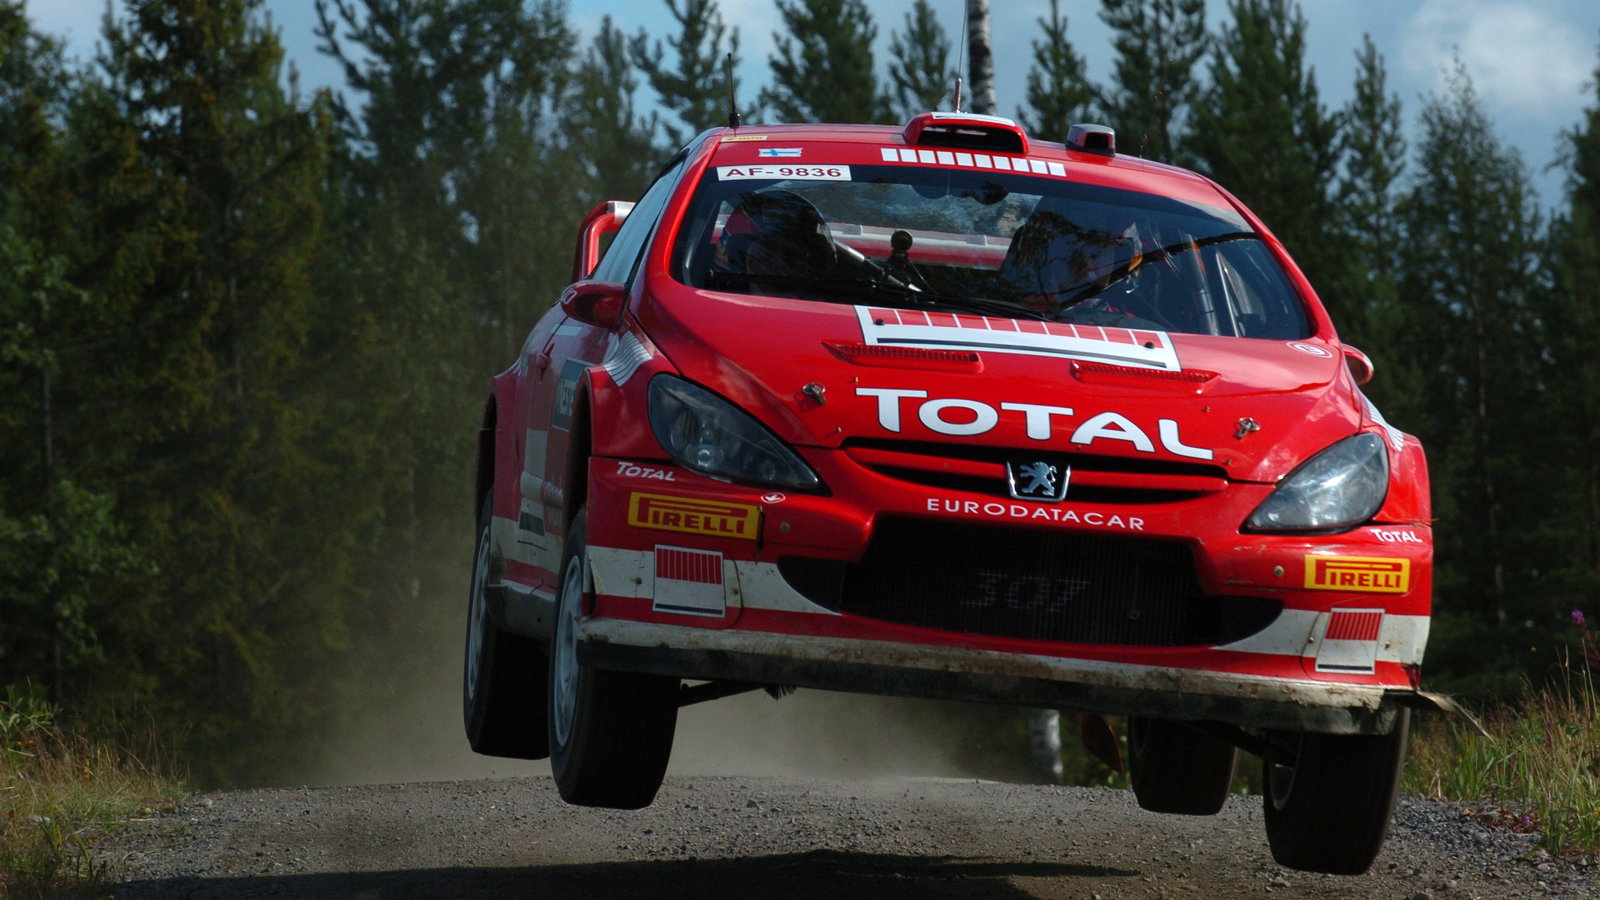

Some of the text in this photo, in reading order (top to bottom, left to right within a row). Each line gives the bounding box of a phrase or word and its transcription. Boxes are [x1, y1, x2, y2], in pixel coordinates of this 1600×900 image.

[726, 167, 842, 178] AF-9836
[855, 387, 1214, 461] TOTAL
[616, 461, 676, 482] TOTAL
[637, 495, 749, 535] PIRELLI
[927, 498, 1145, 531] EURODATACAR
[1369, 528, 1423, 543] TOTAL
[1314, 558, 1403, 589] PIRELLI
[960, 571, 1090, 613] 307
